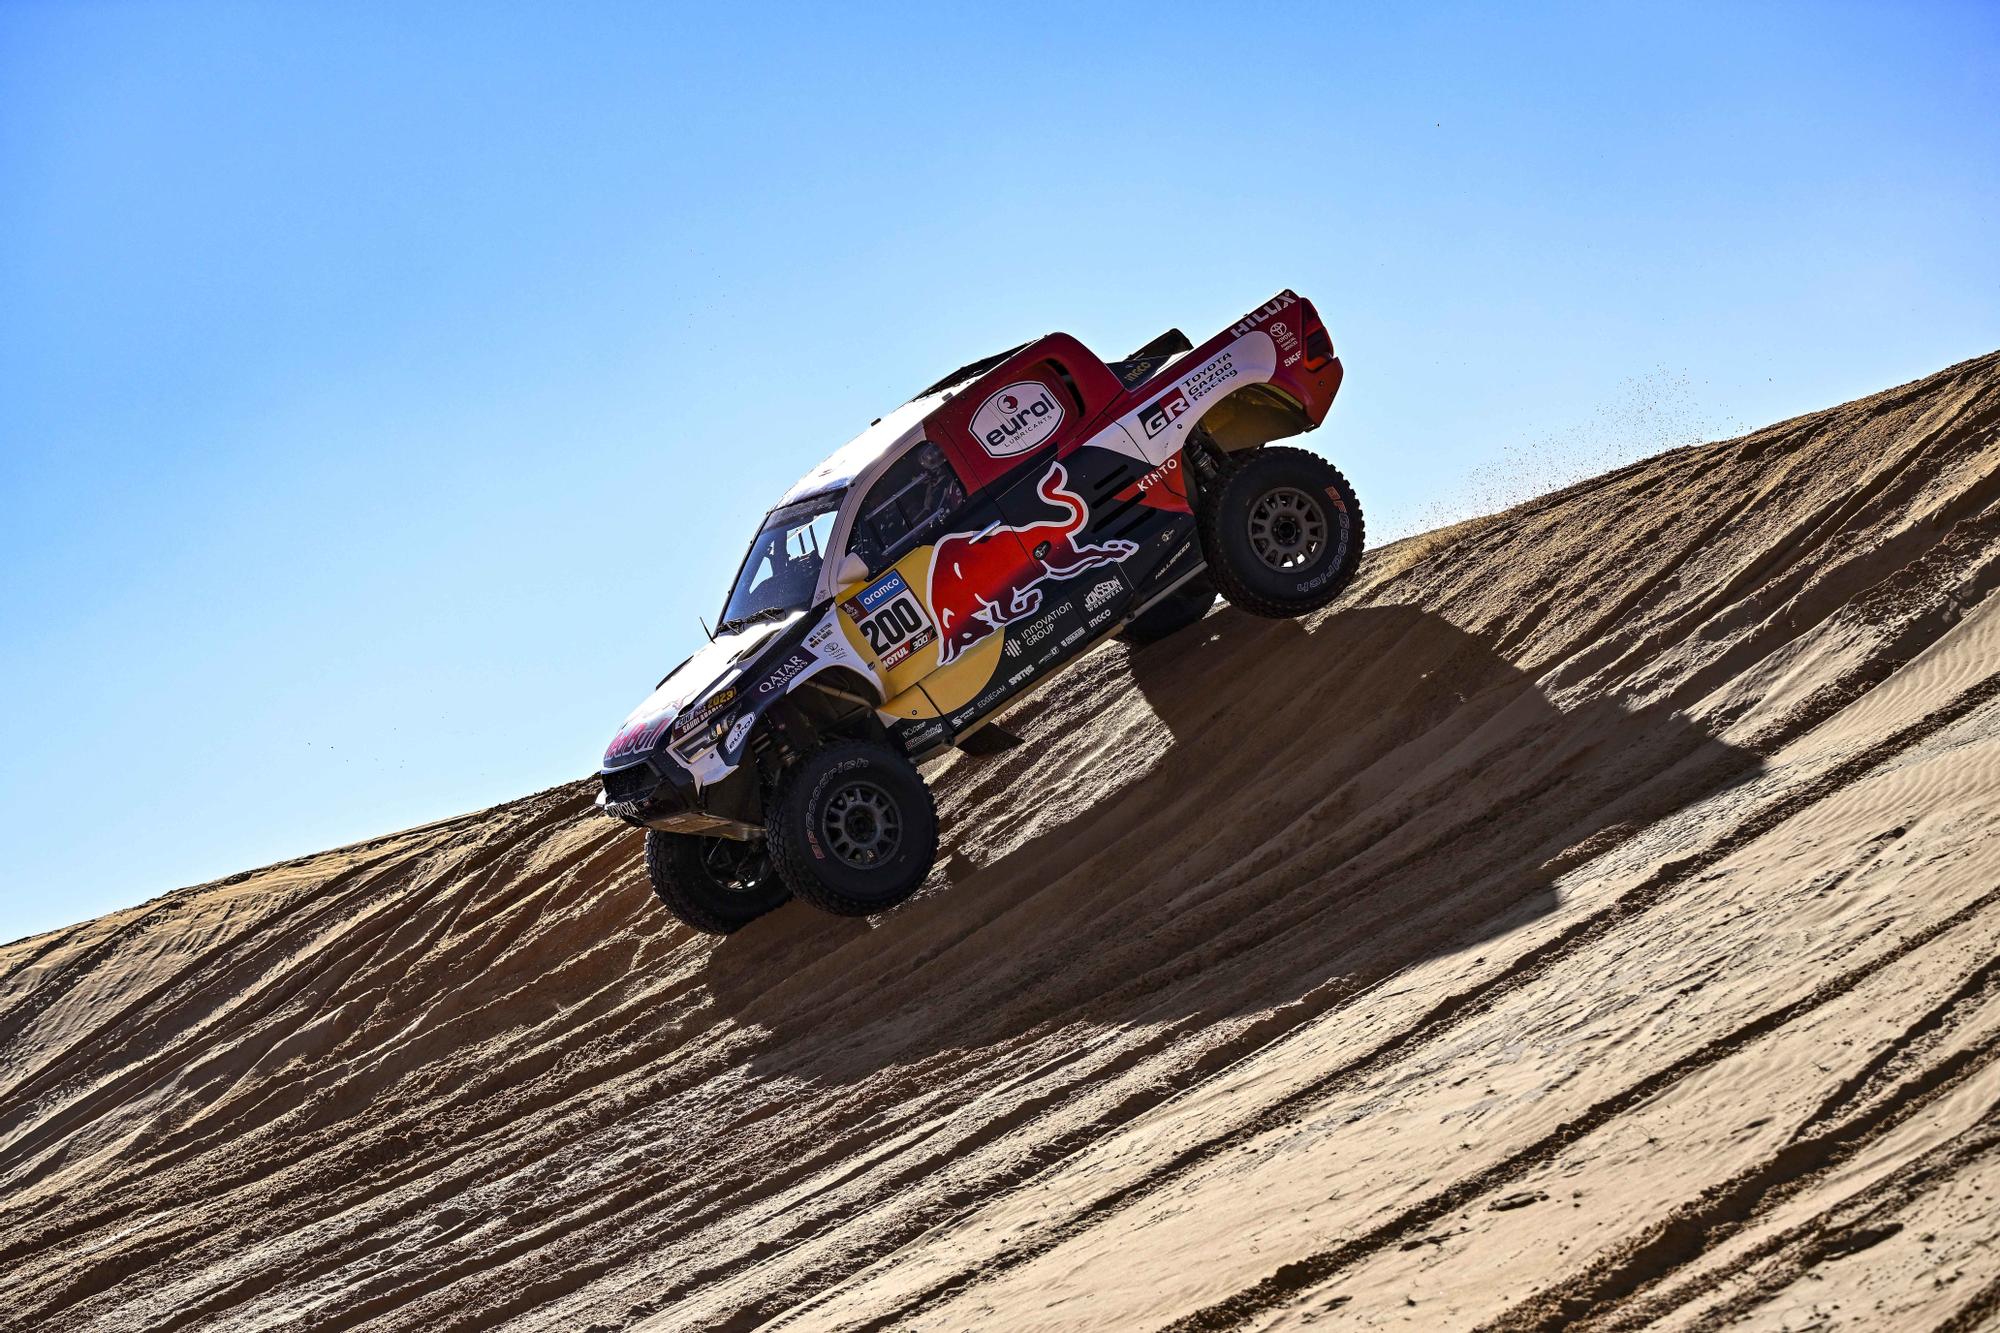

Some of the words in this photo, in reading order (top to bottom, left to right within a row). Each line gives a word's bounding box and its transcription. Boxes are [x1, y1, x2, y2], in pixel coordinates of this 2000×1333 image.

[1230, 291, 1297, 338] HILUX
[1181, 352, 1232, 388] TOYOTA
[1284, 350, 1302, 367] SKF
[1188, 361, 1233, 396] GAZOO
[1192, 368, 1238, 401] Racing
[985, 392, 1056, 447] eurol
[1003, 415, 1053, 448] LUBRICANTS
[1144, 397, 1187, 437] GR
[863, 578, 900, 605] aramco
[1084, 578, 1121, 609] JONSSON
[859, 597, 923, 656] 200
[1026, 623, 1055, 646] GROUP
[759, 655, 803, 693] QATAR
[776, 660, 808, 688] AIRWAYS
[707, 689, 736, 709] 2023
[682, 719, 700, 733] SAUDI
[728, 715, 754, 749] eurol
